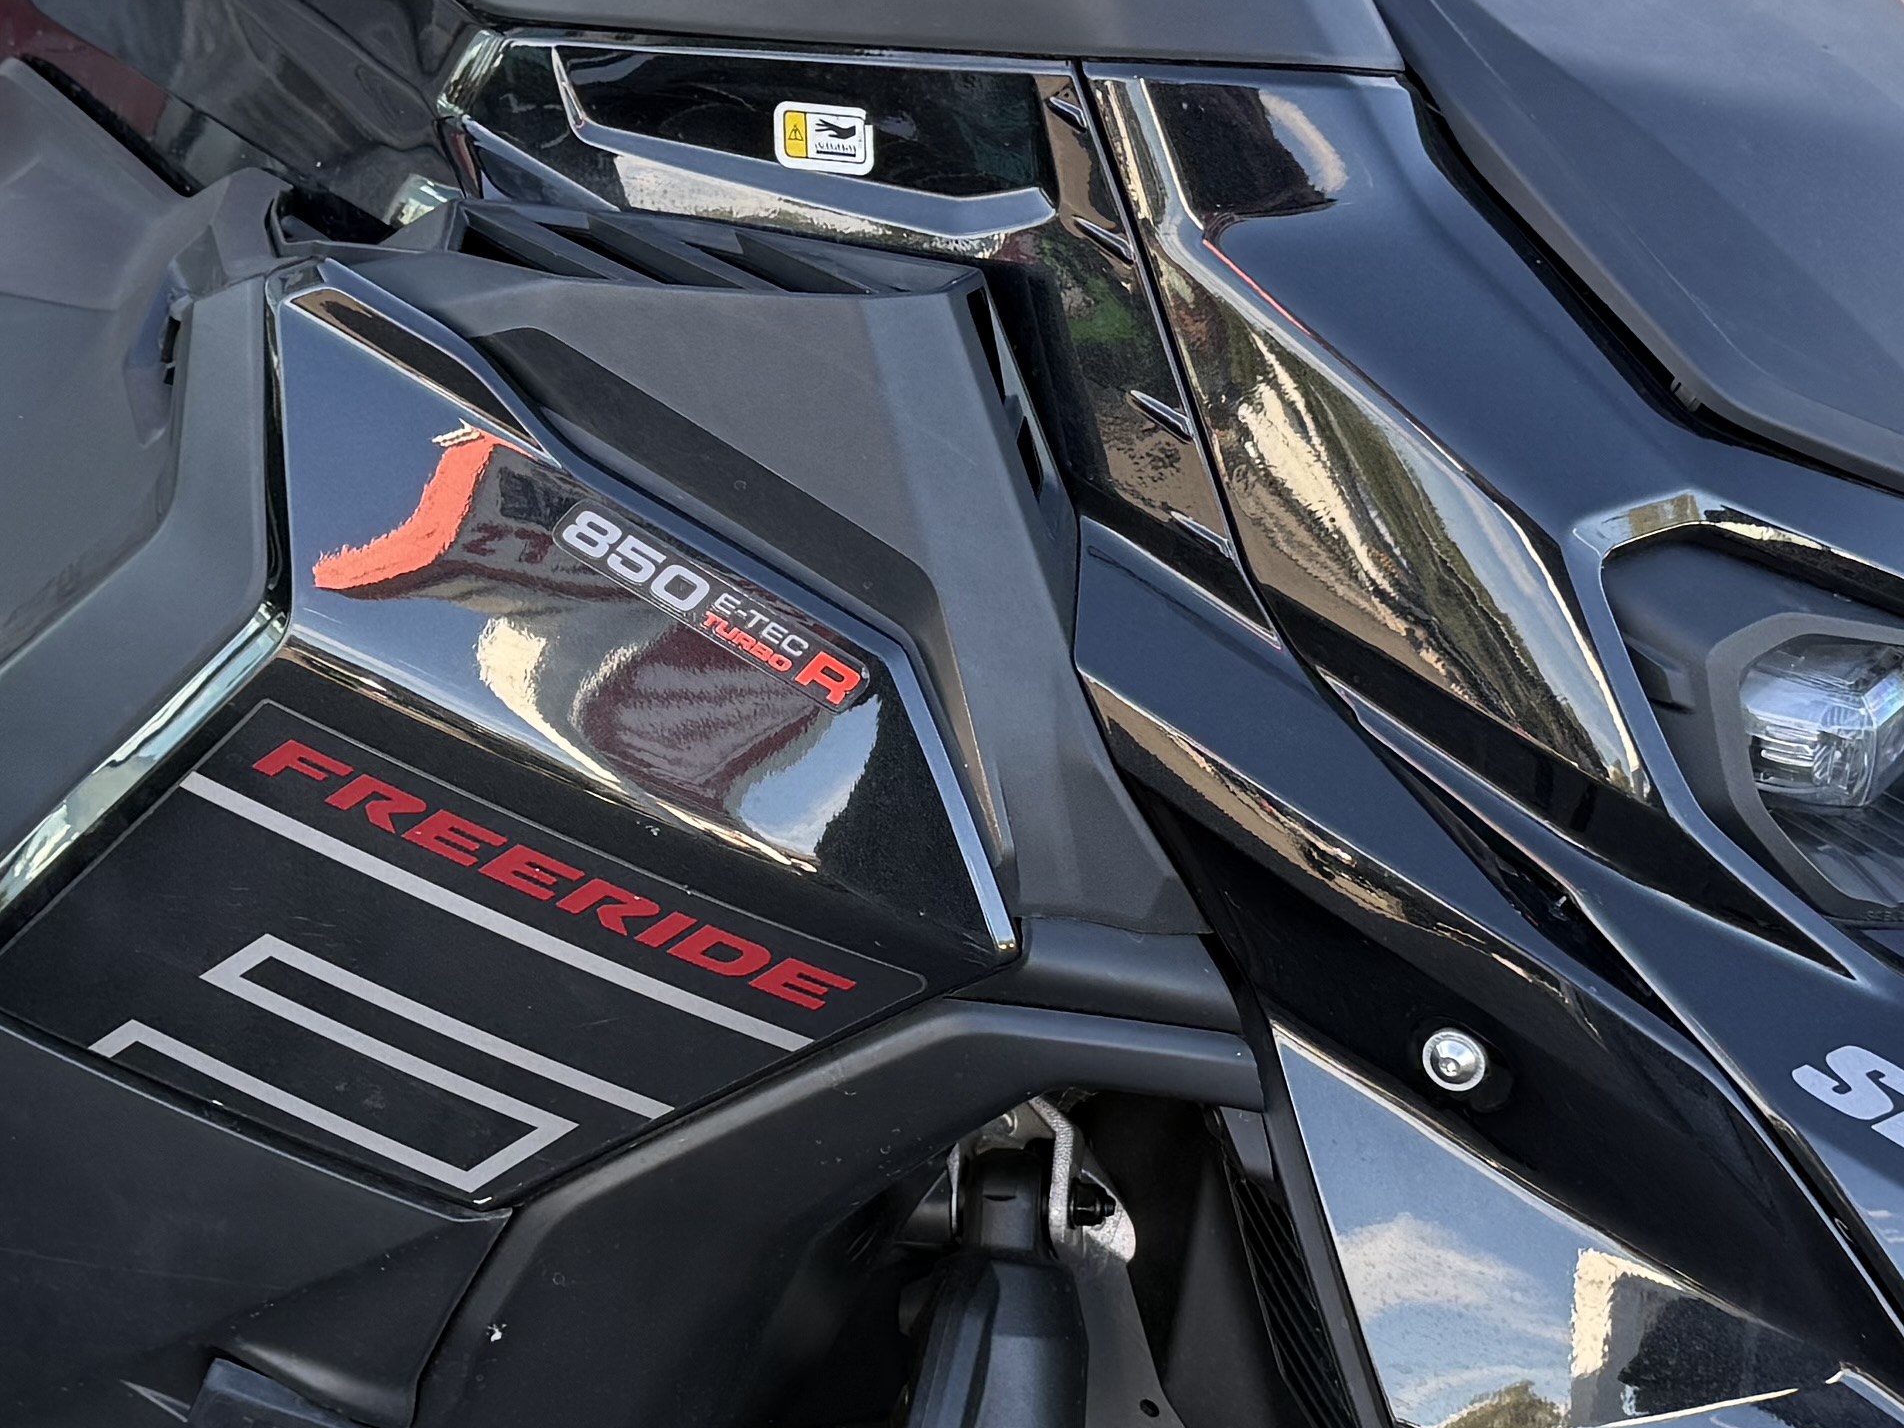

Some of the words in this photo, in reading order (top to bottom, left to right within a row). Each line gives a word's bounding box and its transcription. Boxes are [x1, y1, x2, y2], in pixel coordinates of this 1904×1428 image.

[561, 510, 711, 613] 850
[709, 591, 810, 658] E-TEC
[699, 609, 794, 674] TURBO
[794, 650, 862, 706] R
[252, 738, 858, 1012] FREERIDE
